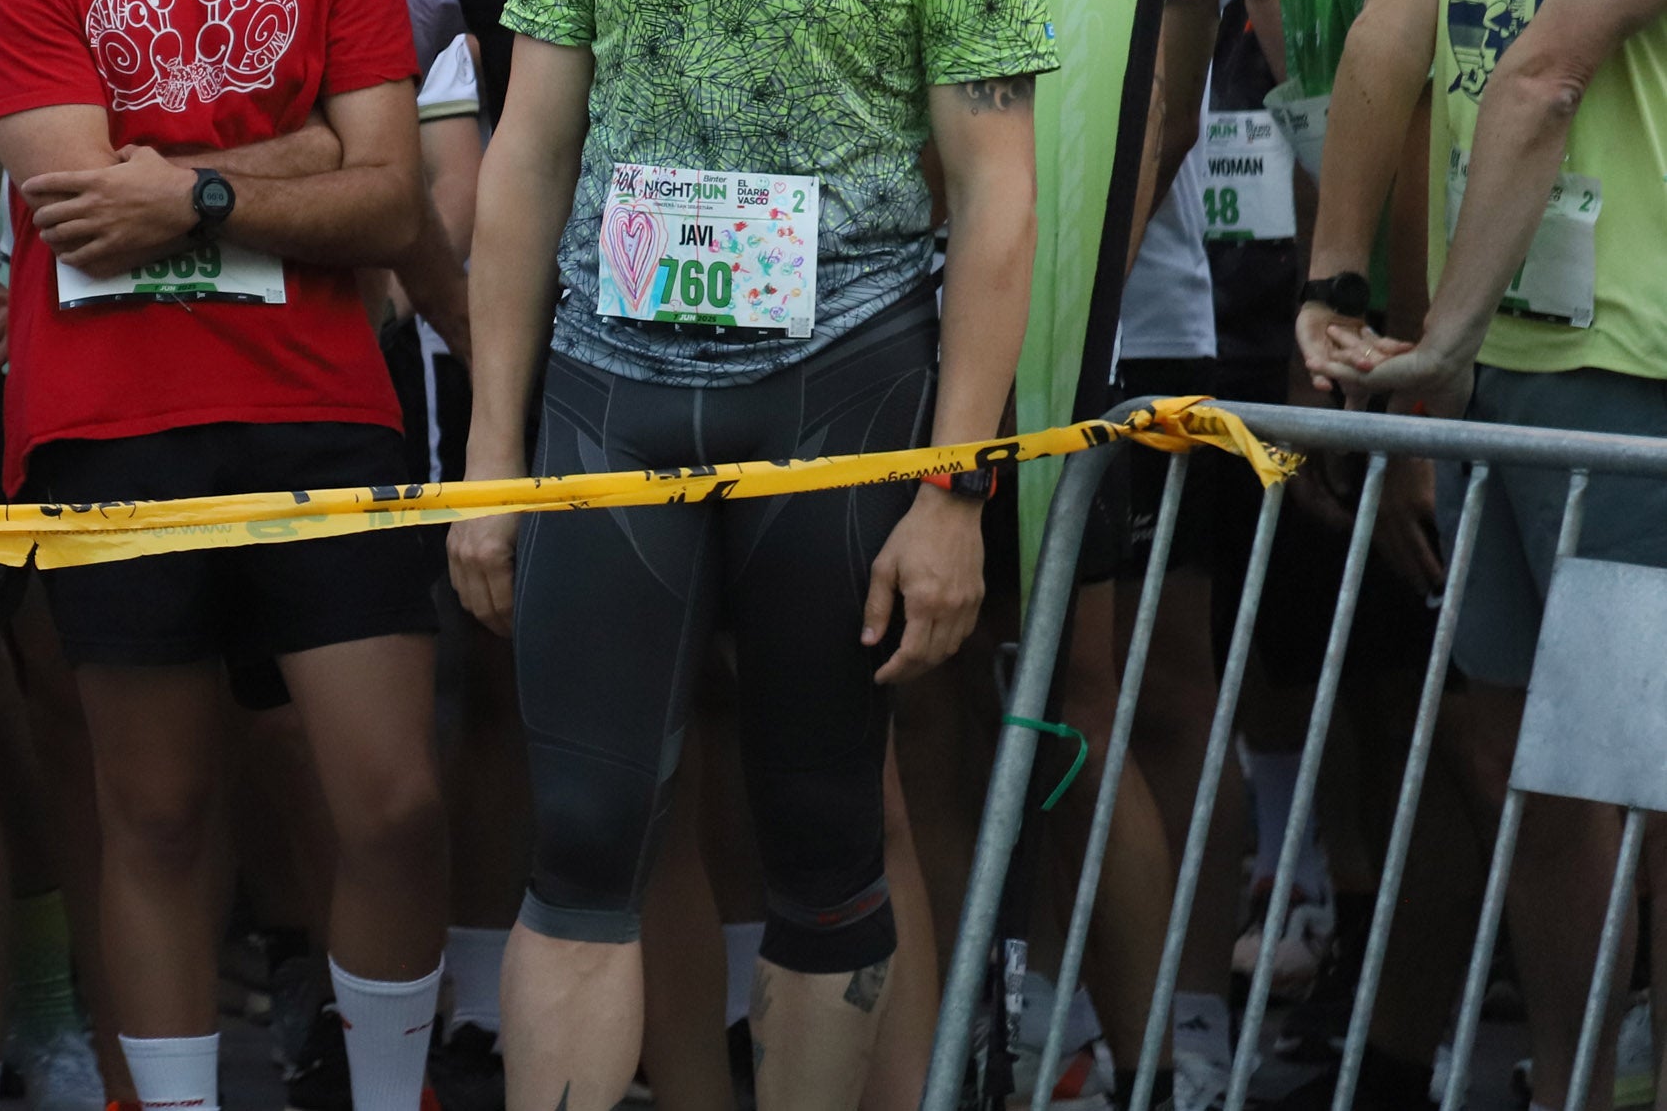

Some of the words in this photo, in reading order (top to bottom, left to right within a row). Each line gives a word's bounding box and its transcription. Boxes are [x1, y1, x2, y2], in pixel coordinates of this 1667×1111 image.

[239, 31, 287, 70] EGUNA
[703, 174, 727, 183] Binter
[738, 179, 748, 188] EL
[737, 187, 769, 197] DIARIO
[737, 197, 769, 206] VASCO
[792, 190, 806, 213] 2
[1578, 191, 1594, 212] 2
[679, 224, 714, 247] JAVI
[659, 258, 733, 309] 760
[679, 314, 696, 322] JUN
